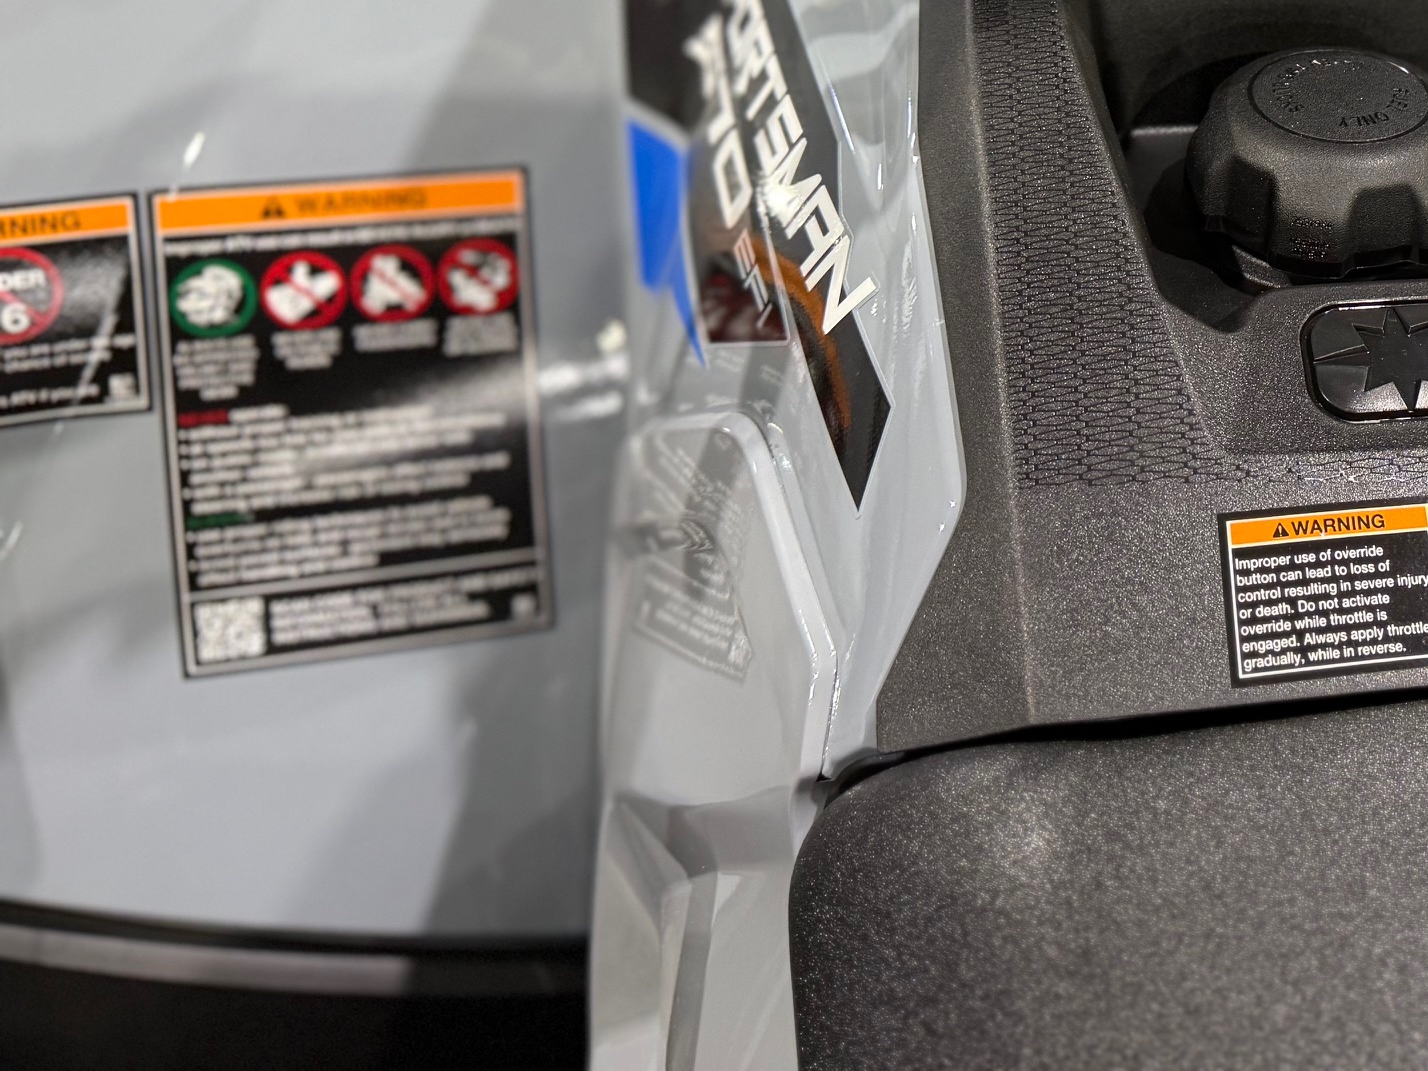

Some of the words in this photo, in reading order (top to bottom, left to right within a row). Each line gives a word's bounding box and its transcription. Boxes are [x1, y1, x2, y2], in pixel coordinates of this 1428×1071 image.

[1291, 514, 1386, 536] WARNING
[1235, 555, 1291, 570] Improper
[1294, 553, 1316, 564] use
[1319, 548, 1331, 561] of
[1334, 545, 1384, 560] override
[1236, 573, 1277, 586] button
[1279, 570, 1303, 582] can
[1305, 565, 1332, 579] lead
[1334, 564, 1347, 576] to
[1350, 563, 1375, 574] loss
[1378, 560, 1390, 572] of
[1238, 586, 1281, 603] control
[1284, 582, 1337, 597] resulting
[1340, 580, 1351, 591] in
[1354, 577, 1395, 590] severe
[1397, 573, 1428, 589] injury
[1239, 608, 1253, 619] or
[1255, 602, 1295, 617] death.
[1297, 600, 1316, 613] Do
[1318, 597, 1339, 610] not
[1342, 593, 1390, 608] activate
[1240, 619, 1292, 636] override
[1294, 615, 1327, 630] while
[1329, 610, 1374, 626] throttle
[1376, 609, 1388, 621] is
[1242, 634, 1300, 653] engaged.
[1304, 631, 1348, 646] Always
[1350, 626, 1384, 642] apply
[1243, 651, 1305, 672] gradually,
[1307, 647, 1340, 661] while
[1343, 645, 1355, 658] in
[1357, 642, 1407, 656] reverse.
